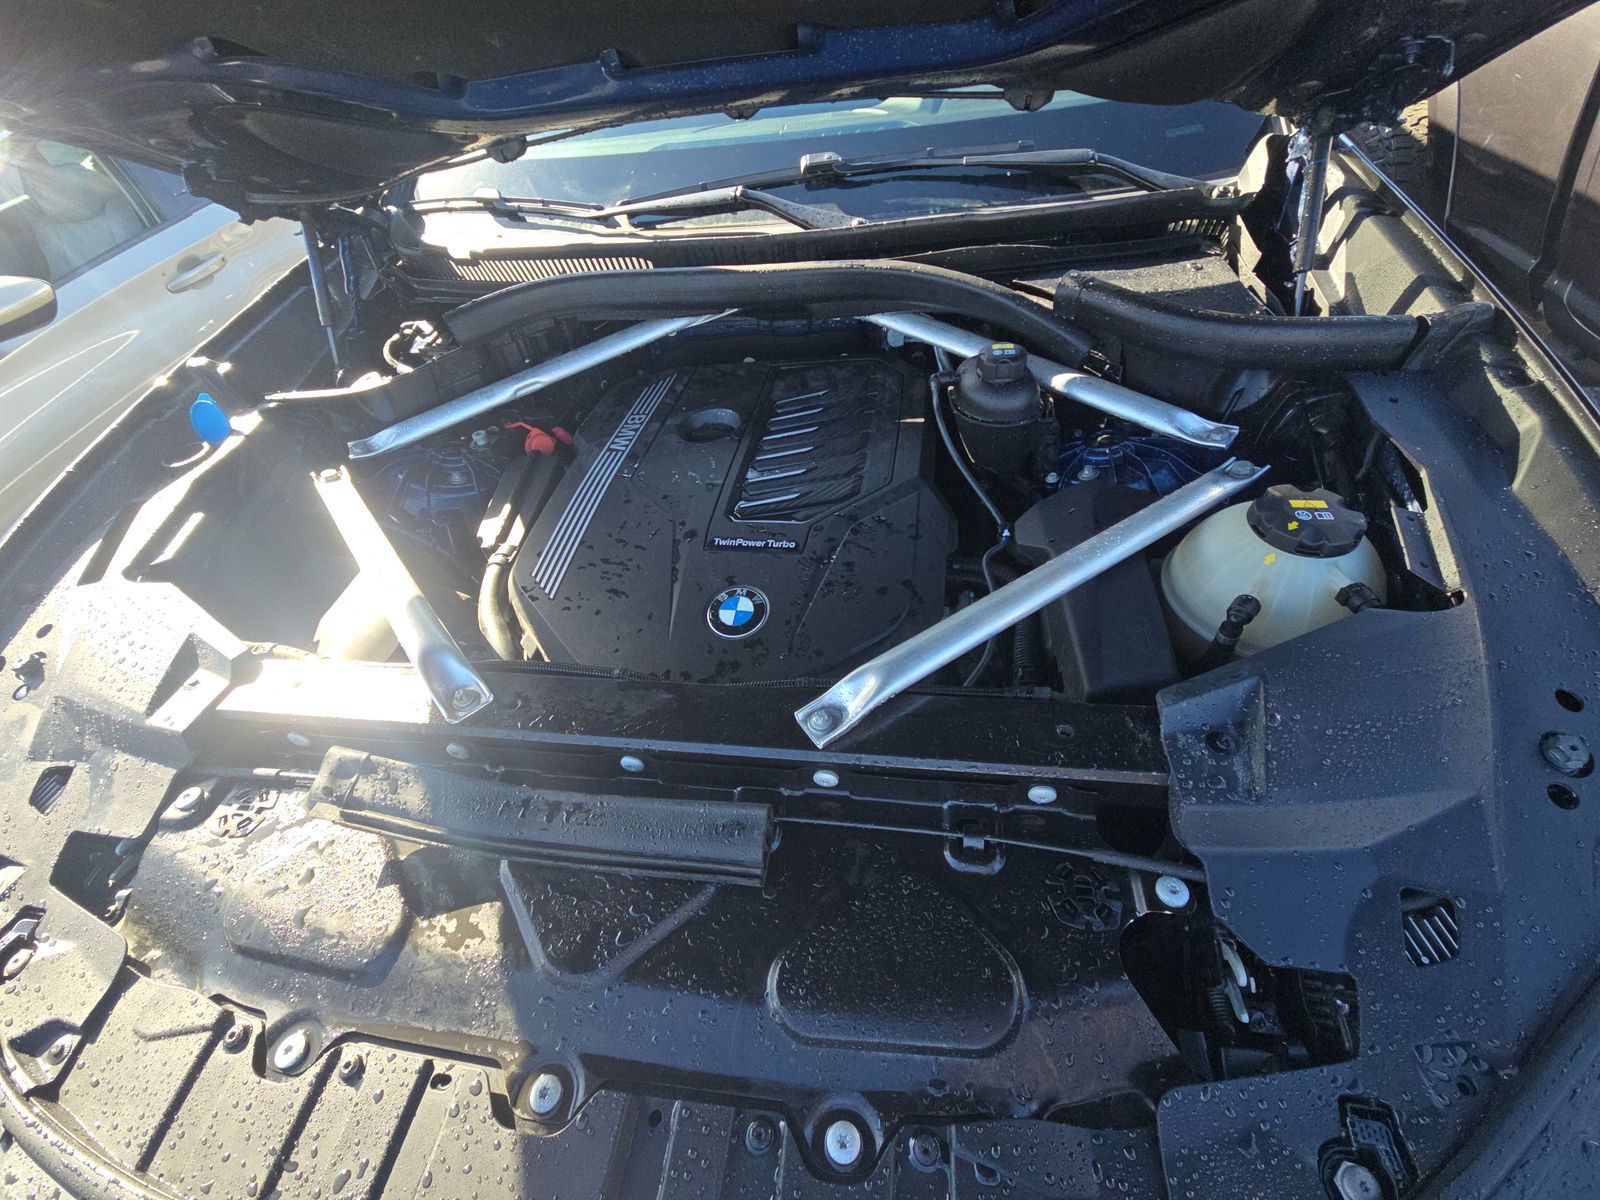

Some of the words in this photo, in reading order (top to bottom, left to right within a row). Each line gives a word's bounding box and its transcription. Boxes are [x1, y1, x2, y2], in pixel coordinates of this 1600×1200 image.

[609, 414, 647, 451] BMW
[713, 537, 766, 548] TwinPower
[767, 539, 796, 549] Turbo
[717, 587, 763, 605] BMW
